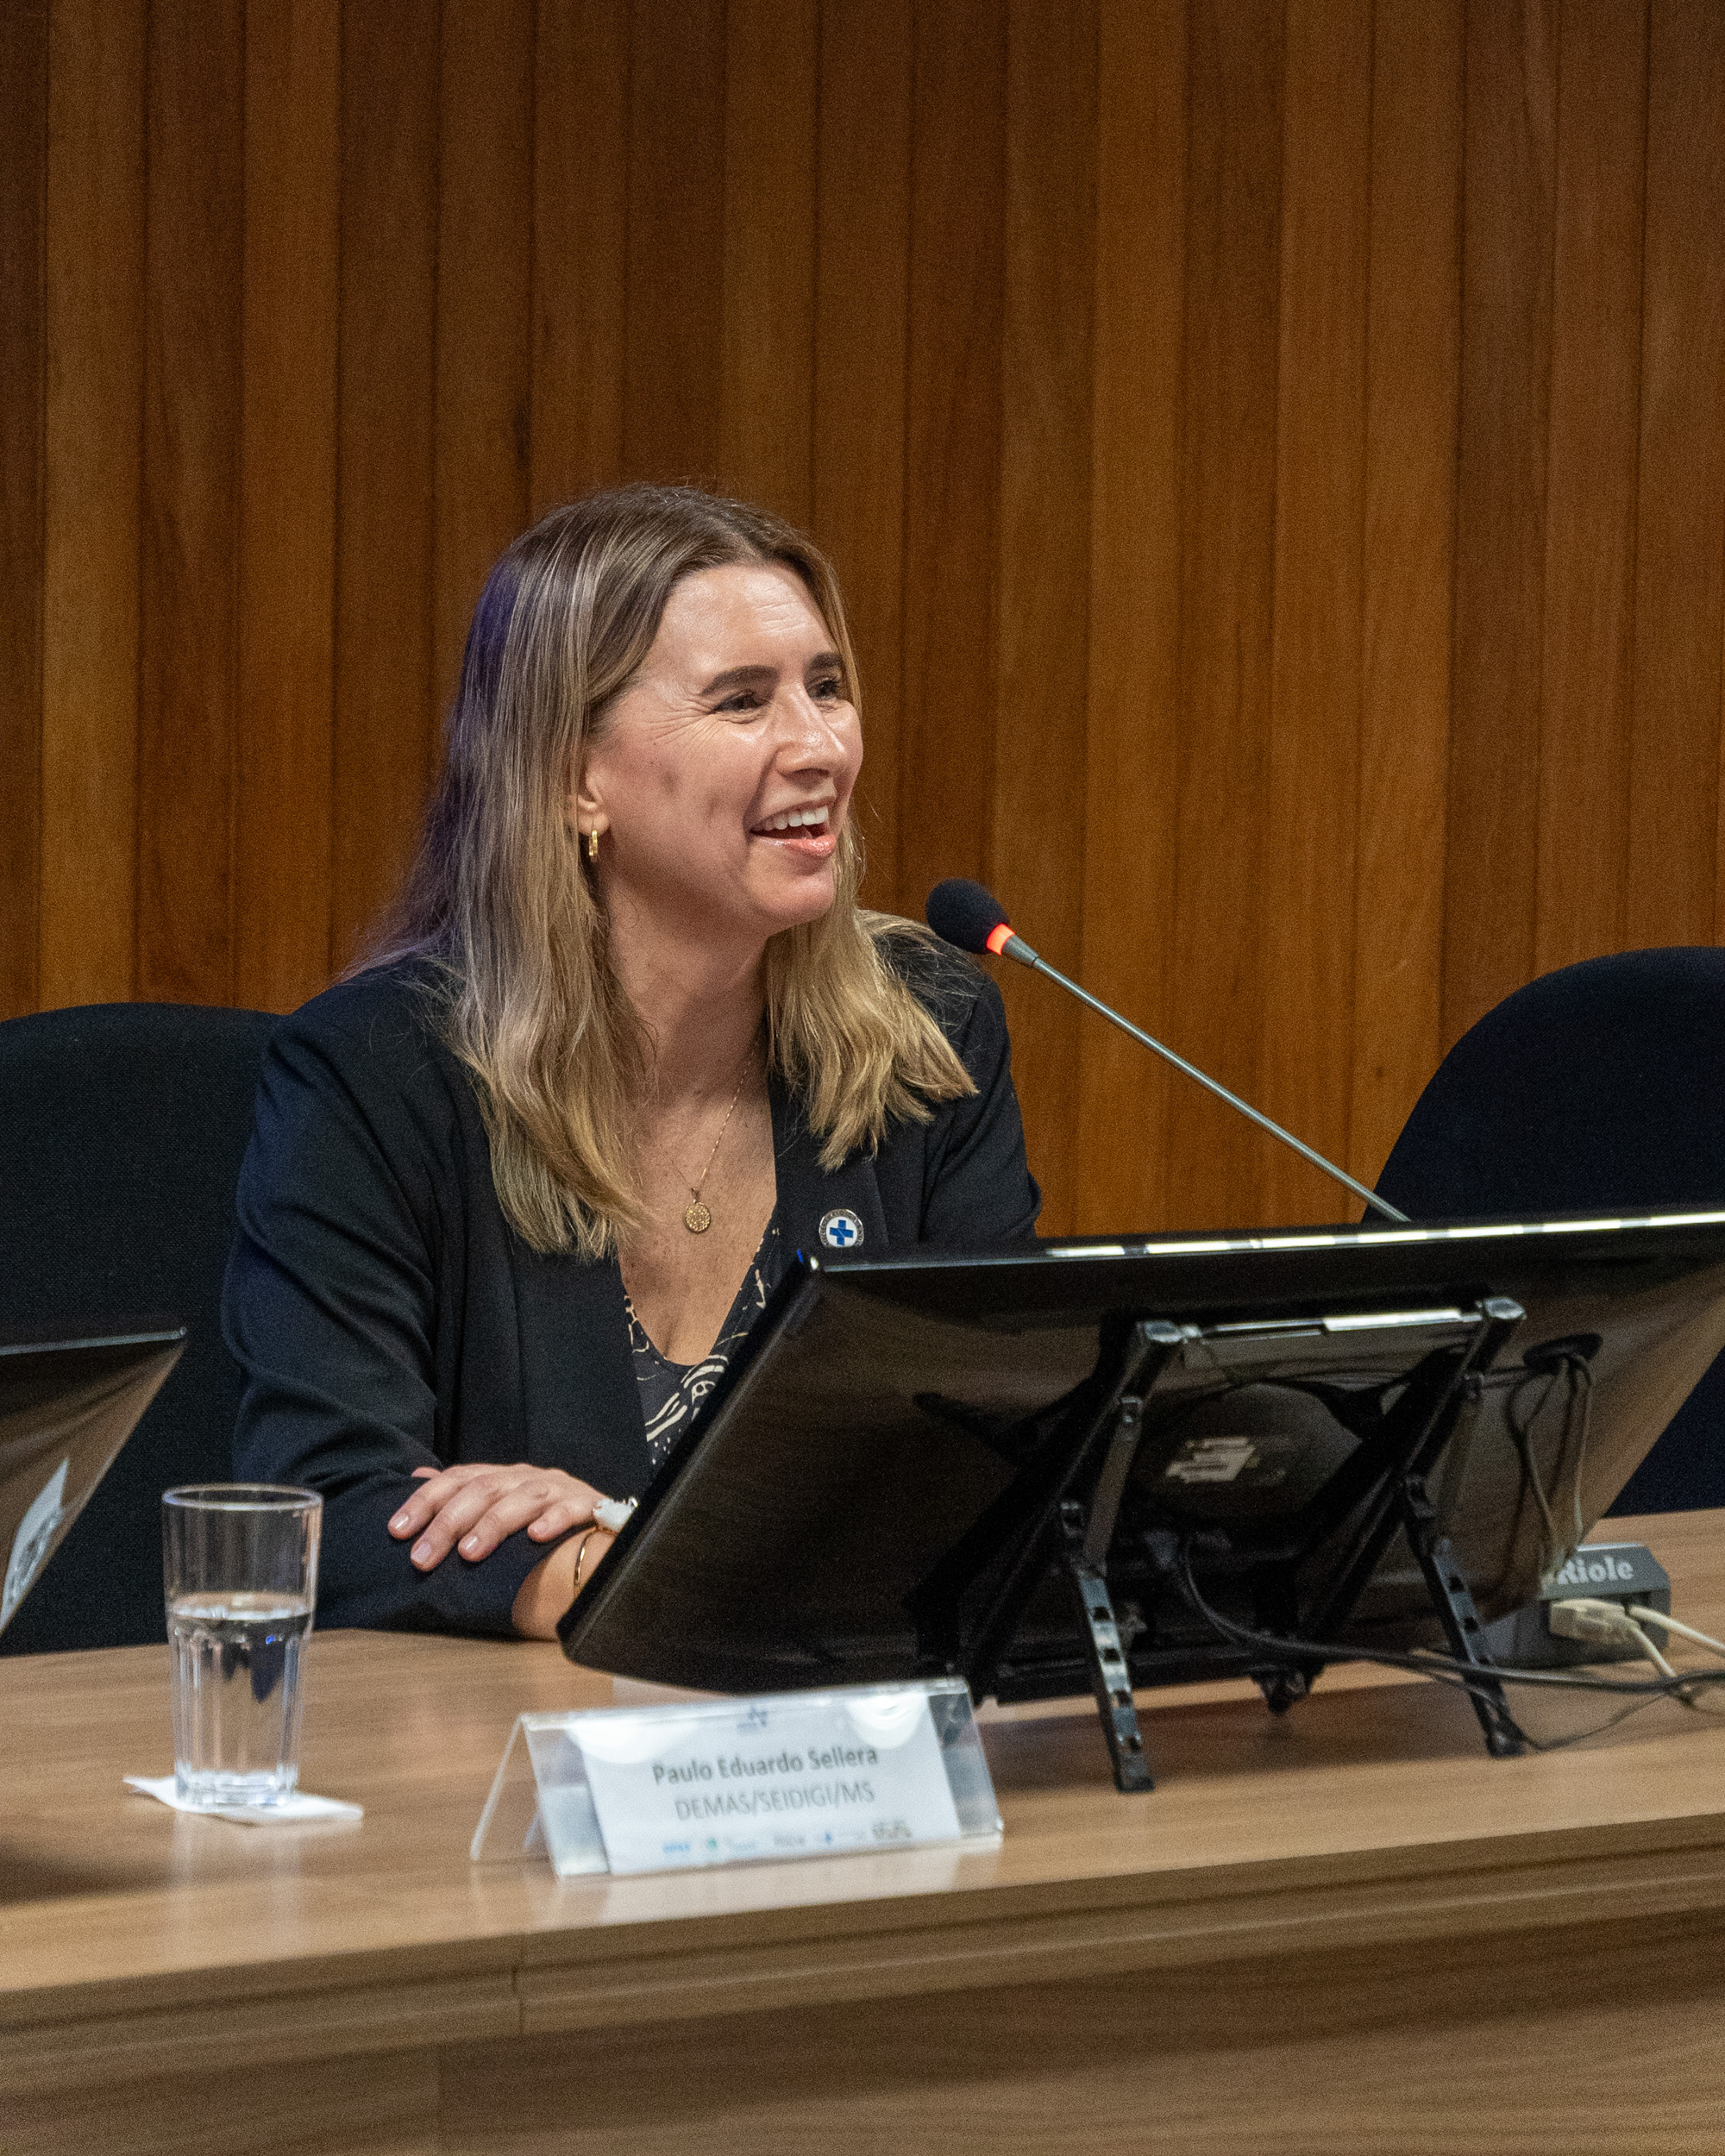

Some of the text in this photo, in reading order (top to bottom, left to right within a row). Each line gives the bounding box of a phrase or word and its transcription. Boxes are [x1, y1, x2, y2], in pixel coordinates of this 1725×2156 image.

[652, 1744, 878, 1786] Paulo Eduardo Sellera
[674, 1780, 875, 1821] DEMAS/SEIDIGI/MS
